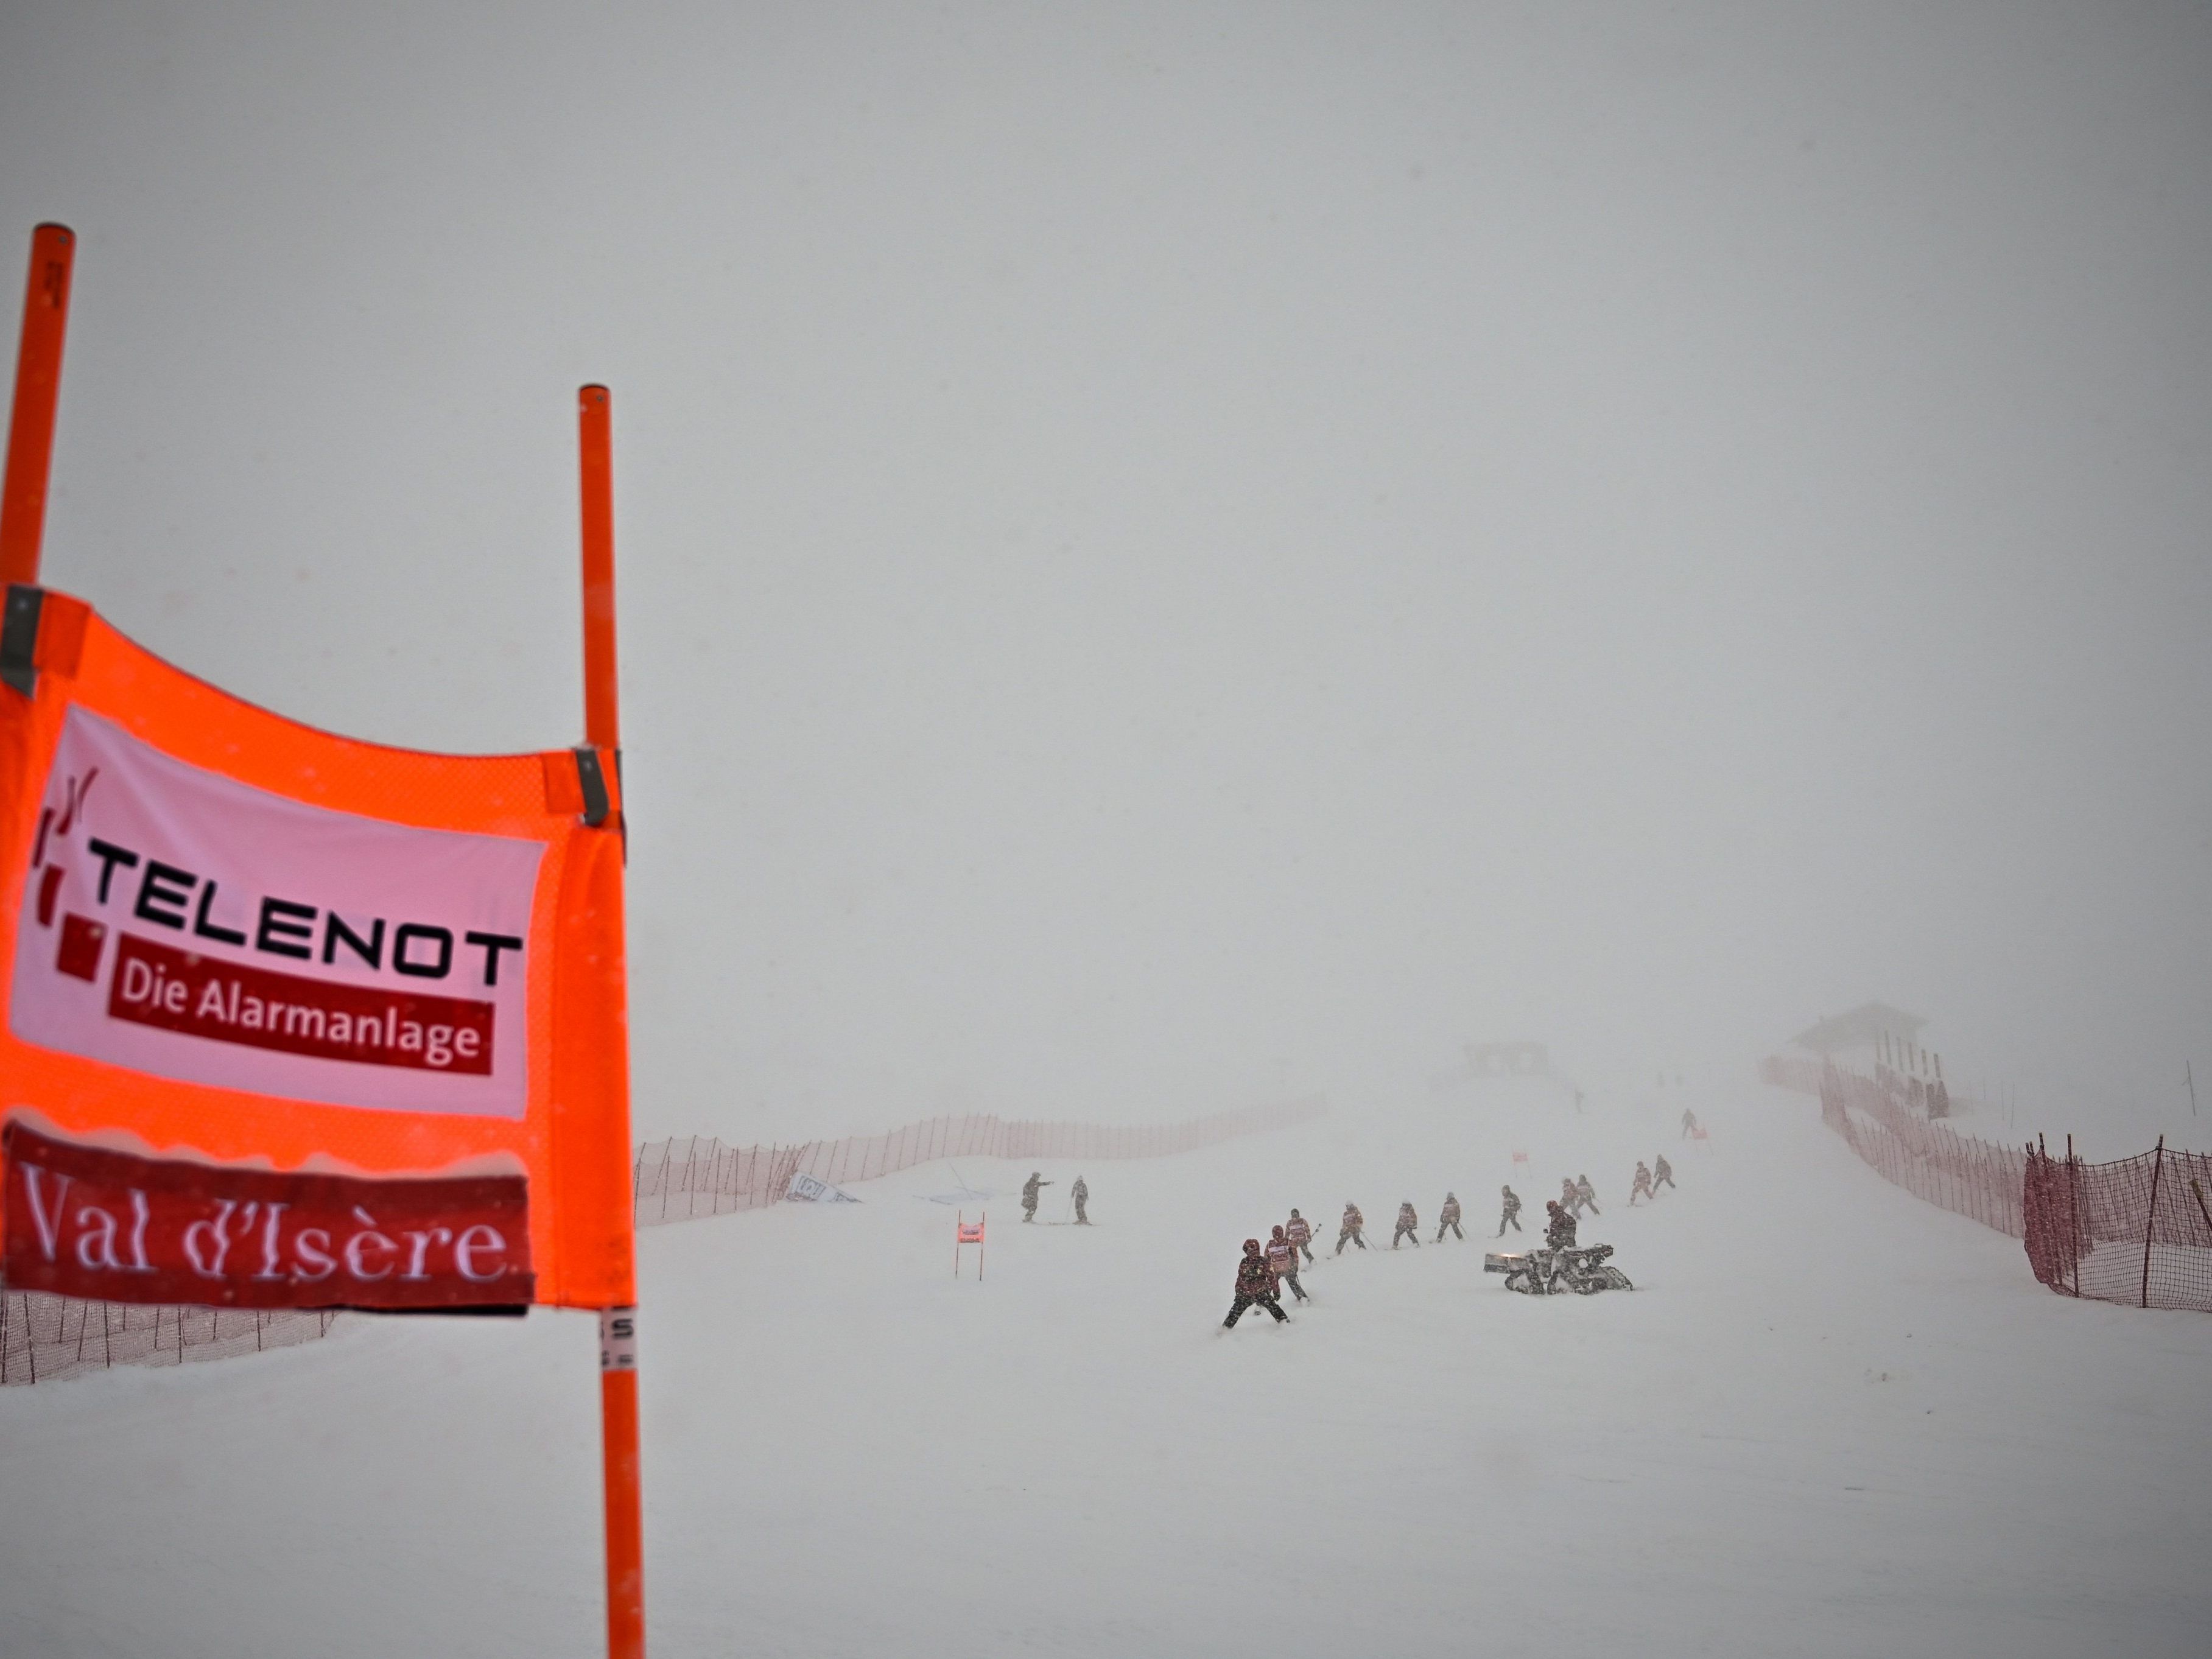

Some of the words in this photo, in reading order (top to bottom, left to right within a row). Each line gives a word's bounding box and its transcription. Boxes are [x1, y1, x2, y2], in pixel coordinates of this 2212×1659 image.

[88, 838, 522, 987] TELENOT
[123, 959, 188, 1013] Die
[197, 978, 479, 1065] Alarmanlage
[19, 1162, 158, 1271] Val
[183, 1199, 507, 1280] d'Isère
